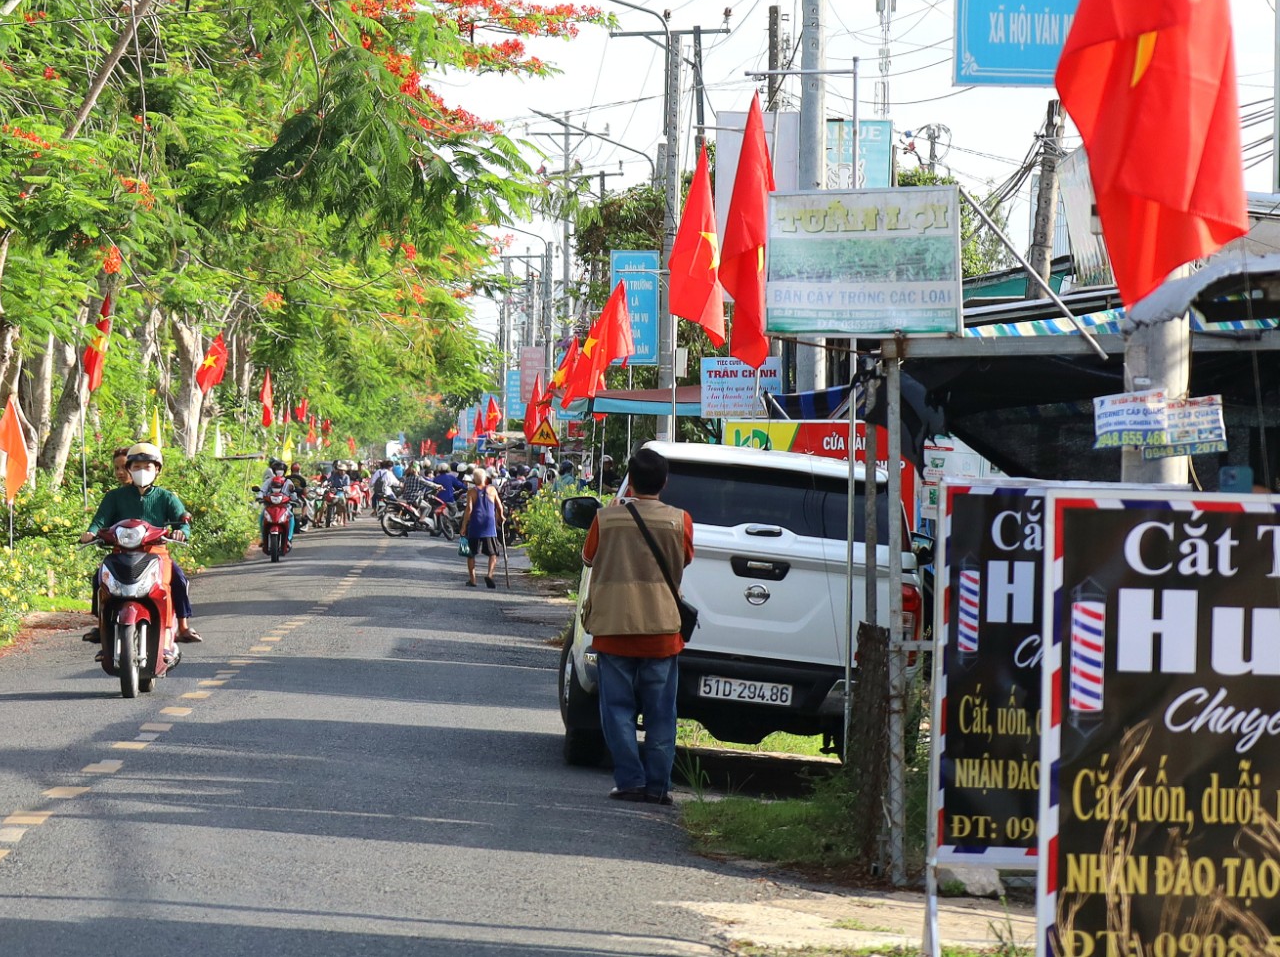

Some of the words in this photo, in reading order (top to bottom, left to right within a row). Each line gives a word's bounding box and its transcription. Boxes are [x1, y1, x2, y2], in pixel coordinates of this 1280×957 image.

[988, 4, 1006, 44] XÃ
[1009, 4, 1031, 51] HỘI
[1035, 7, 1060, 45] VĂN
[886, 203, 949, 234] LỢI
[629, 278, 654, 291] TRƯỜNG
[921, 289, 951, 307] LOẠI
[631, 295, 639, 307] LÀ
[640, 313, 649, 323] VỤ
[637, 344, 650, 355] DÂN
[741, 369, 777, 378] CHNH
[823, 431, 844, 451] CỬA
[1124, 510, 1240, 577] Cắt
[987, 560, 1035, 624] H
[1117, 588, 1280, 676] Hu
[703, 678, 789, 704] 51D-294.86
[959, 683, 993, 743] Cắt,
[997, 684, 1032, 744] uốn,
[955, 752, 1004, 795] NHẬN
[1072, 753, 1129, 833] Cắt,
[1137, 754, 1195, 835] uốn,
[950, 814, 998, 839] ĐT:
[1005, 816, 1040, 840] 09
[1066, 844, 1149, 904] NHẬN
[1154, 846, 1216, 897] ĐÀO
[1222, 857, 1280, 907] TẠO
